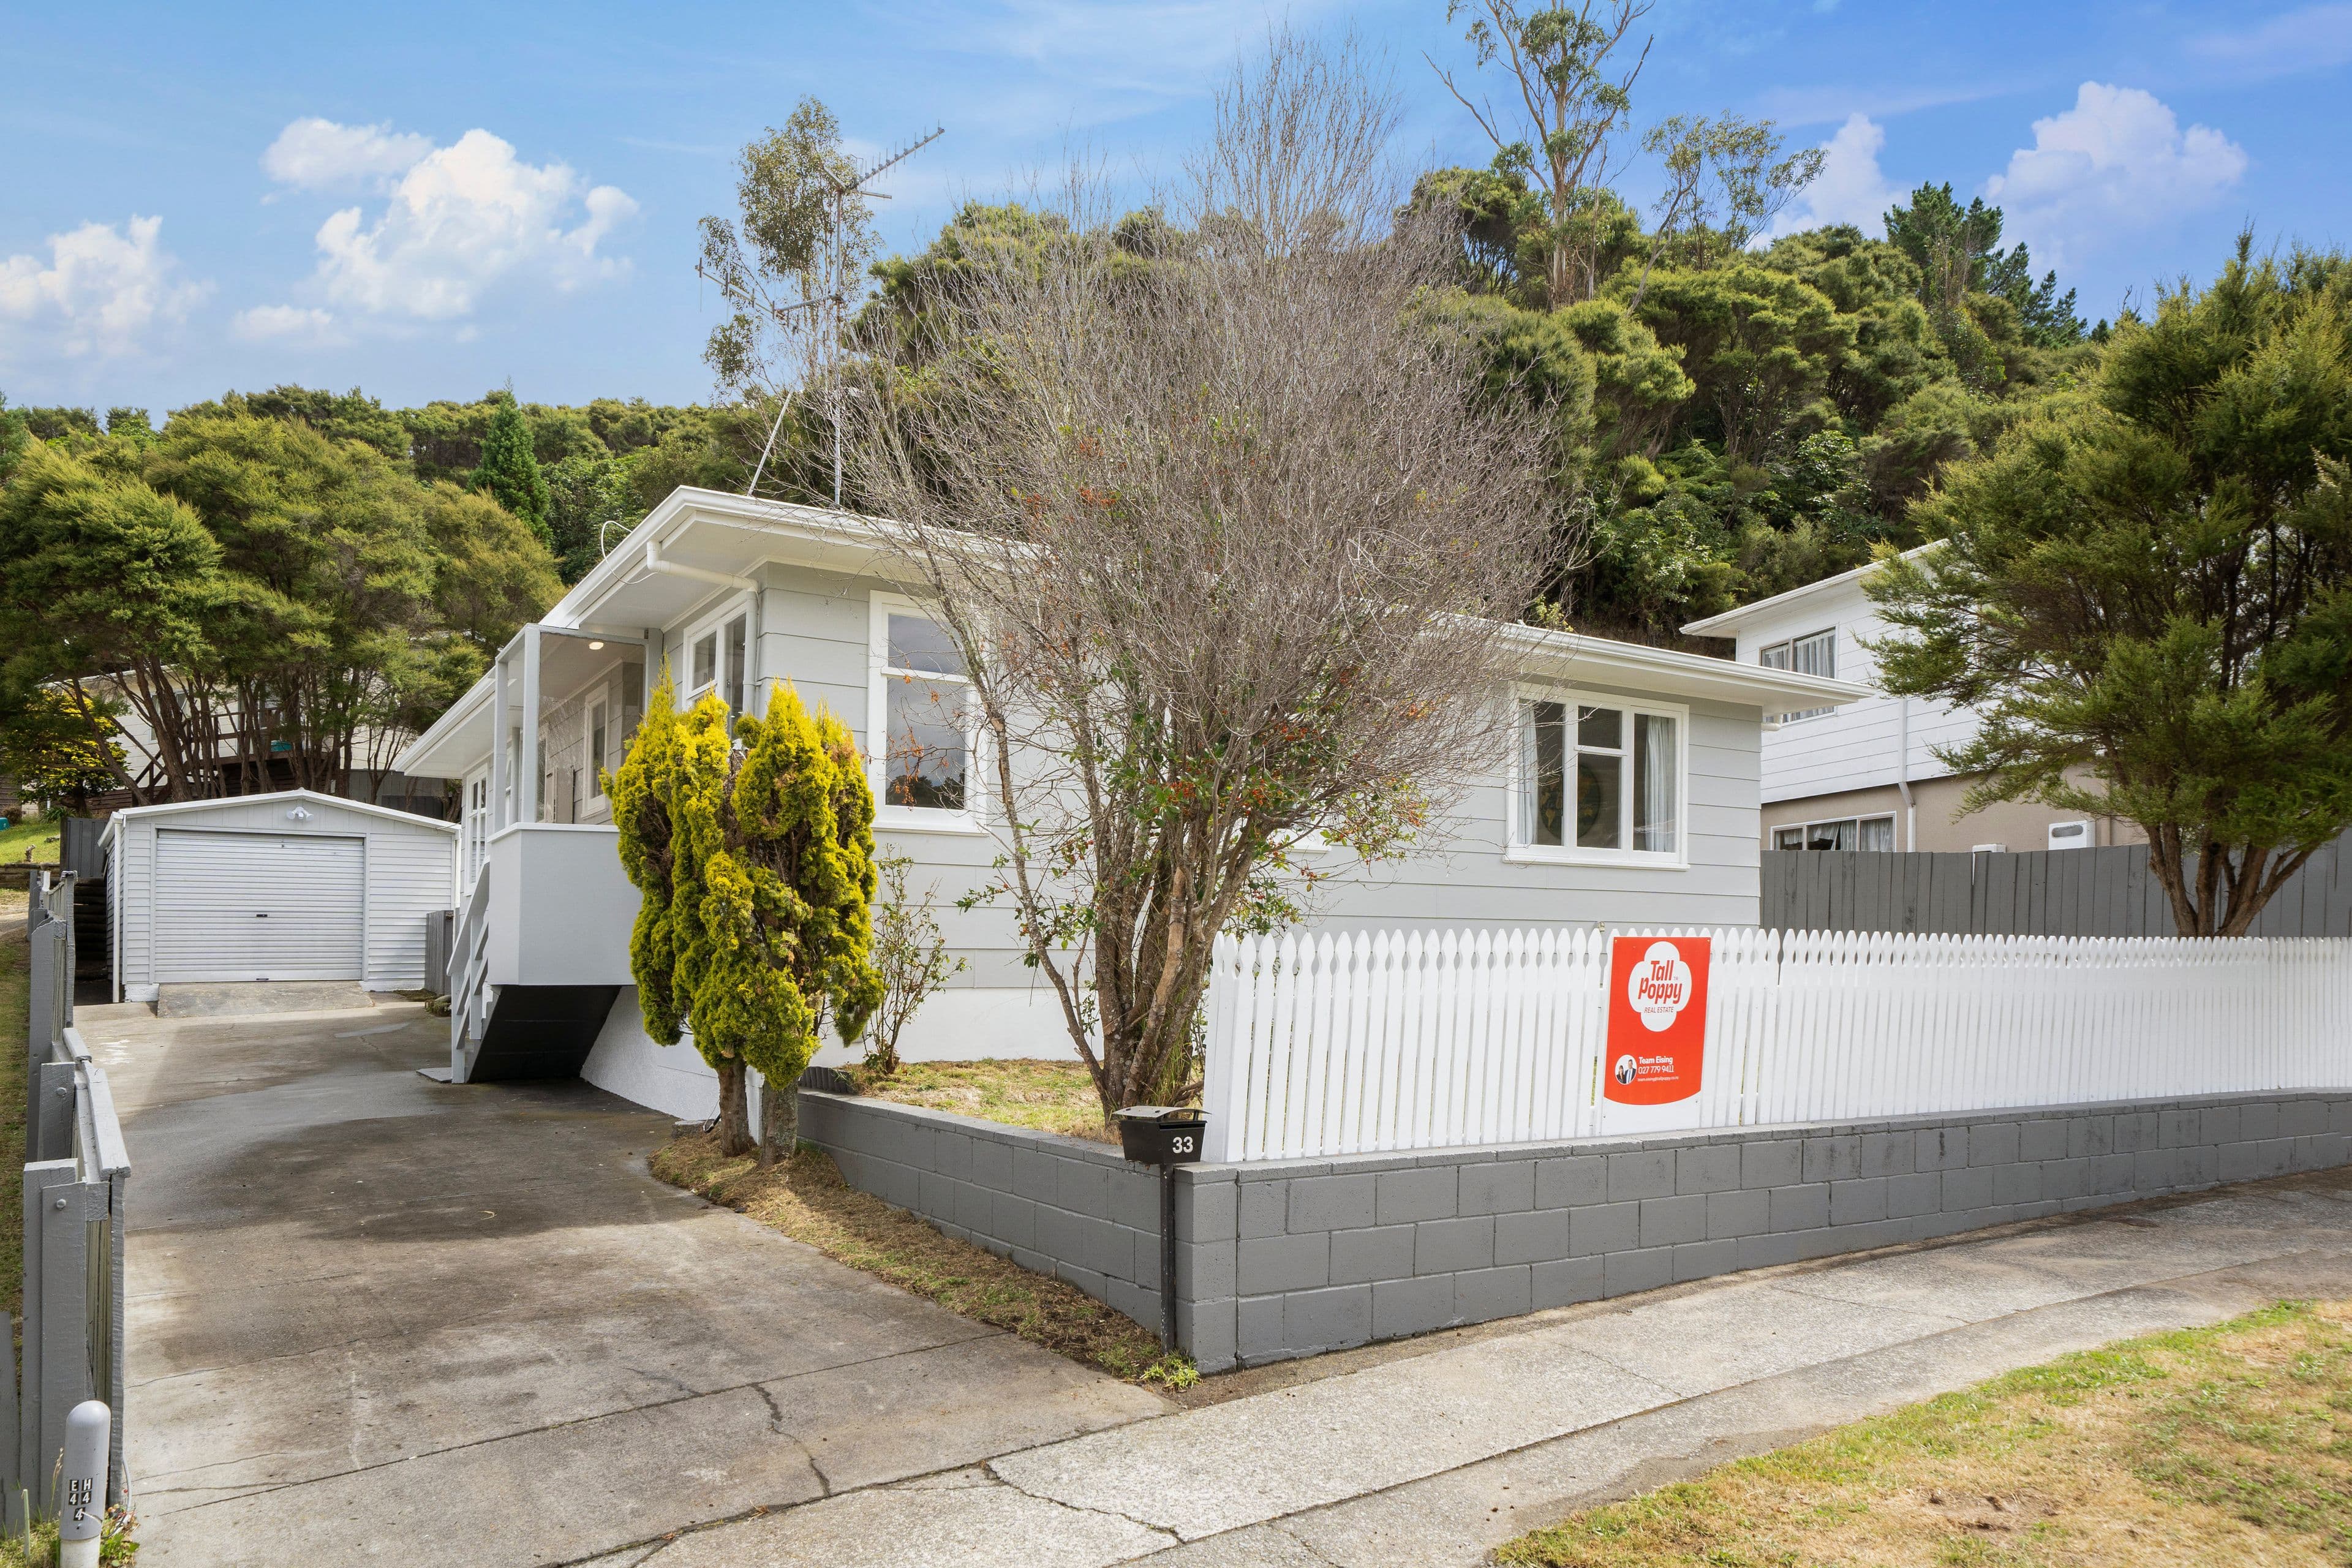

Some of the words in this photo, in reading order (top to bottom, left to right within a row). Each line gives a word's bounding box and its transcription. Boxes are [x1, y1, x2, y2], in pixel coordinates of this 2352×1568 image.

[1651, 960, 1674, 981] Tall
[1656, 1055, 1673, 1065] Eising
[1638, 1066, 1649, 1074] 027
[1650, 1065, 1661, 1074] 779
[1662, 1065, 1675, 1073] 9411
[1172, 1136, 1193, 1153] 33
[75, 1508, 83, 1520] 4
